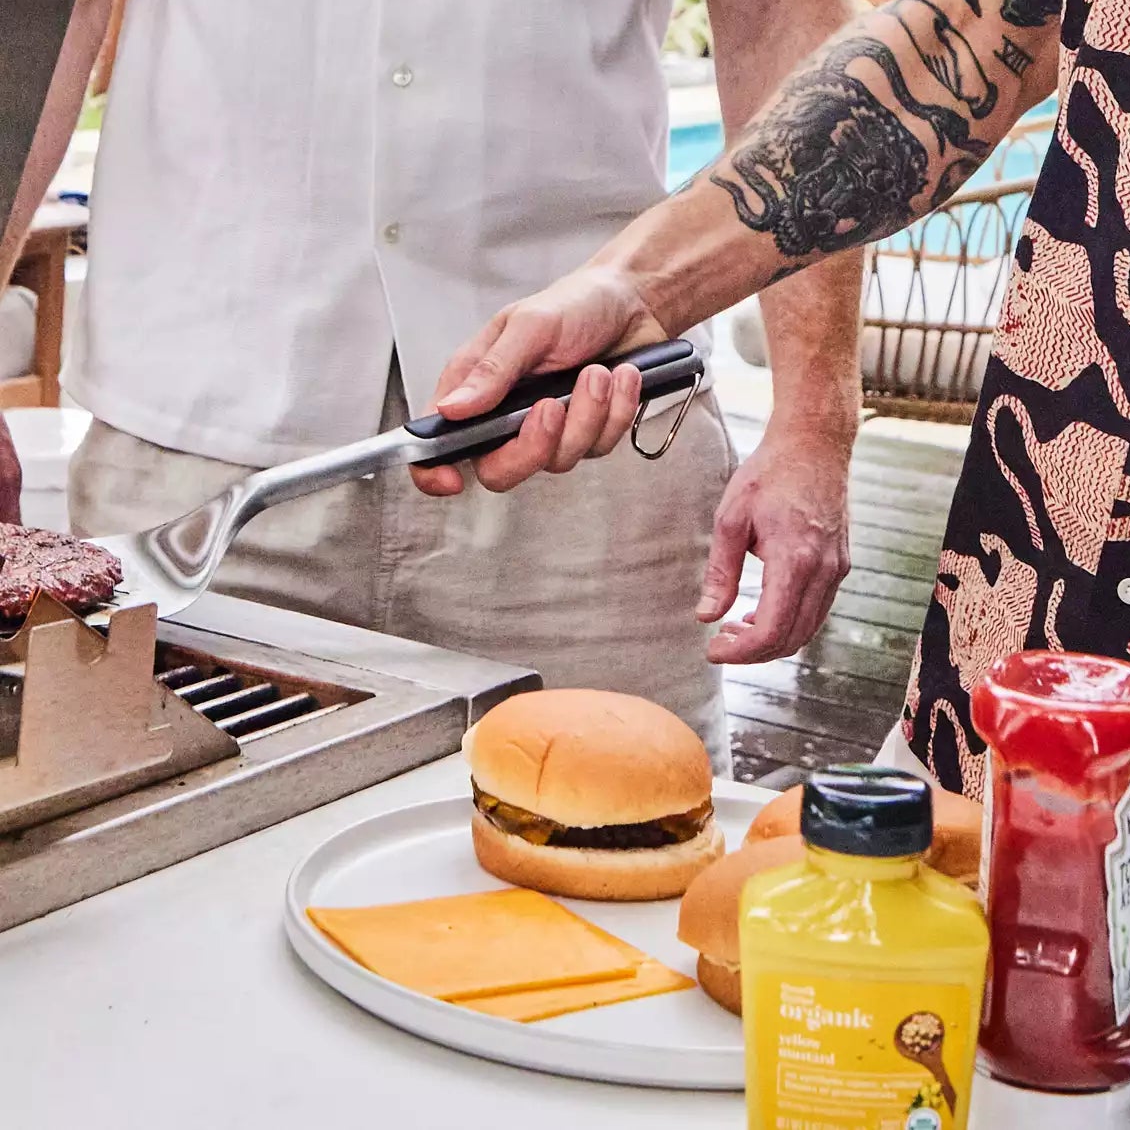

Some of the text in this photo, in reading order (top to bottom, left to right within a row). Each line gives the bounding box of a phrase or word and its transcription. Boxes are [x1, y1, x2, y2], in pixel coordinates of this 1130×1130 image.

[779, 1003, 874, 1032] organic
[778, 1033, 821, 1050] yellow
[778, 1047, 835, 1066] mustard
